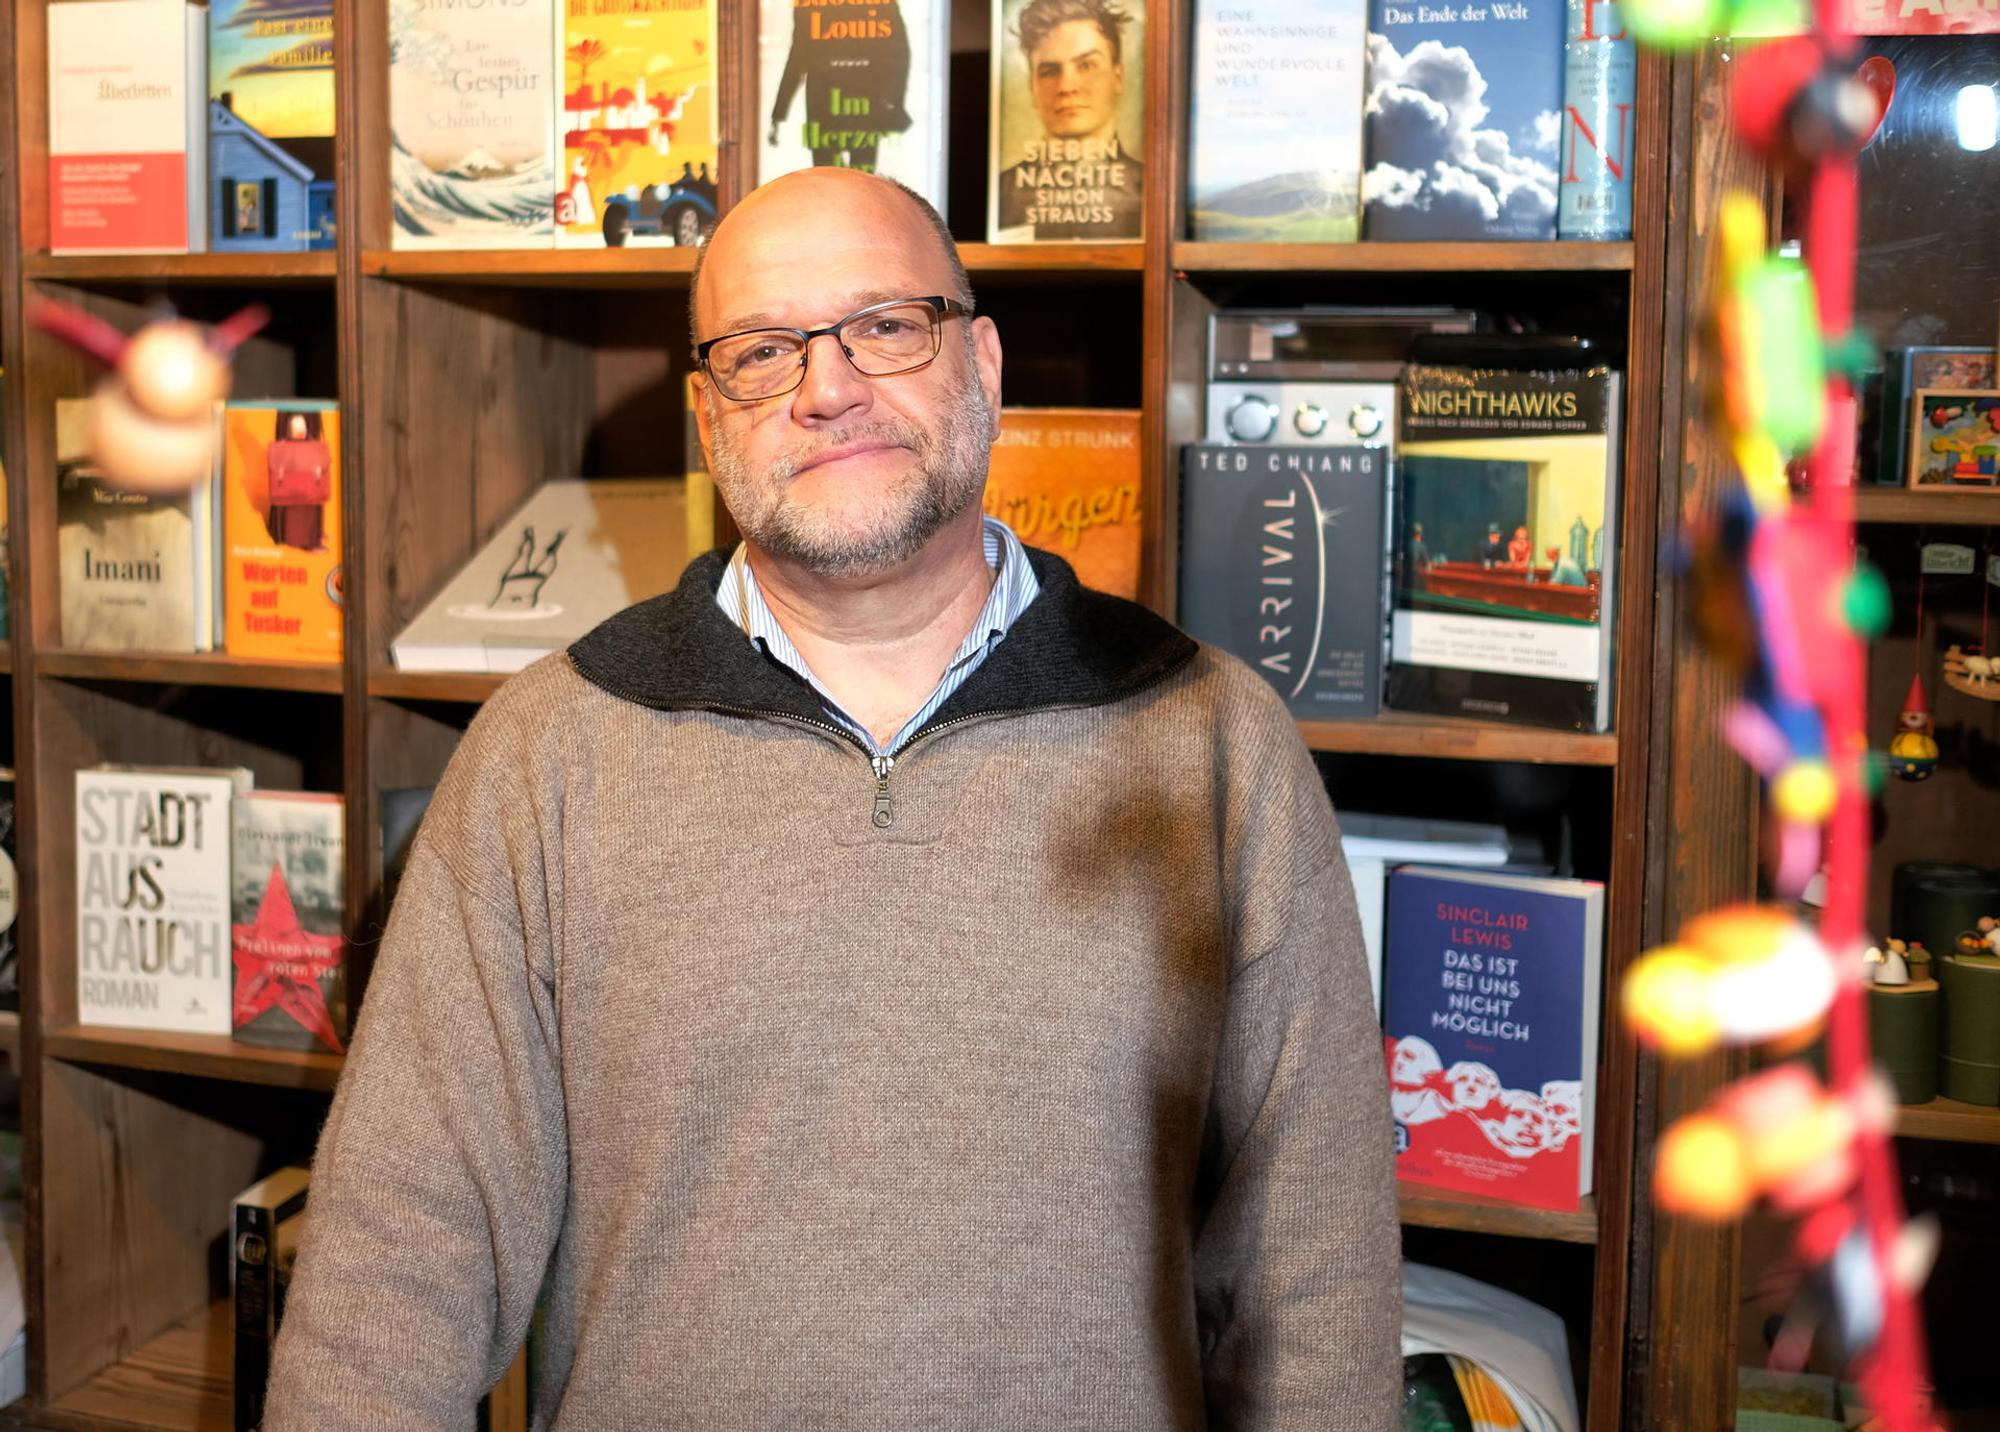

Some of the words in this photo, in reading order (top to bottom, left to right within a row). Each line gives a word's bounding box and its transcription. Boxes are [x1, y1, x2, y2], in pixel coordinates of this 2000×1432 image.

[810, 9, 892, 40] Louis
[1216, 9, 1256, 22] EINE
[1384, 7, 1414, 25] Das
[1417, 5, 1457, 23] Ende
[1460, 4, 1488, 21] der
[1491, 2, 1529, 20] Welt
[1216, 25, 1338, 39] WAHNSINNIGE
[1216, 43, 1251, 54] UND
[1216, 58, 1346, 72] WUNDERVOLLE
[453, 67, 540, 99] Gespür
[1216, 74, 1259, 87] WELT
[831, 88, 870, 116] Im
[1024, 139, 1119, 163] SIEBEN
[1015, 161, 1126, 188] NÄCHTE
[1036, 189, 1105, 207] SIMON
[1025, 206, 1114, 225] STRAUSS
[1412, 391, 1577, 417] NIGHTHAWKS
[1049, 430, 1133, 448] STRUNK
[1199, 453, 1248, 472] TED
[1268, 454, 1372, 474] CHIANG
[84, 548, 161, 582] Imani
[243, 562, 307, 585] Warten
[1260, 489, 1295, 674] ARRIVAL
[251, 588, 278, 609] auf
[244, 611, 302, 635] Tusker
[81, 787, 211, 850] STADT
[81, 851, 165, 912] AUS
[1437, 902, 1530, 931] SINCLAIR
[81, 914, 220, 979] RAUCH
[1452, 927, 1512, 950] LEWIS
[1443, 949, 1483, 972] DAS
[1487, 956, 1519, 977] IST
[82, 976, 159, 1010] ROMAN
[1441, 970, 1473, 992] BEI
[1478, 976, 1521, 999] UNS
[1449, 993, 1513, 1019] NICHT
[1431, 1009, 1530, 1043] MÖGLICH
